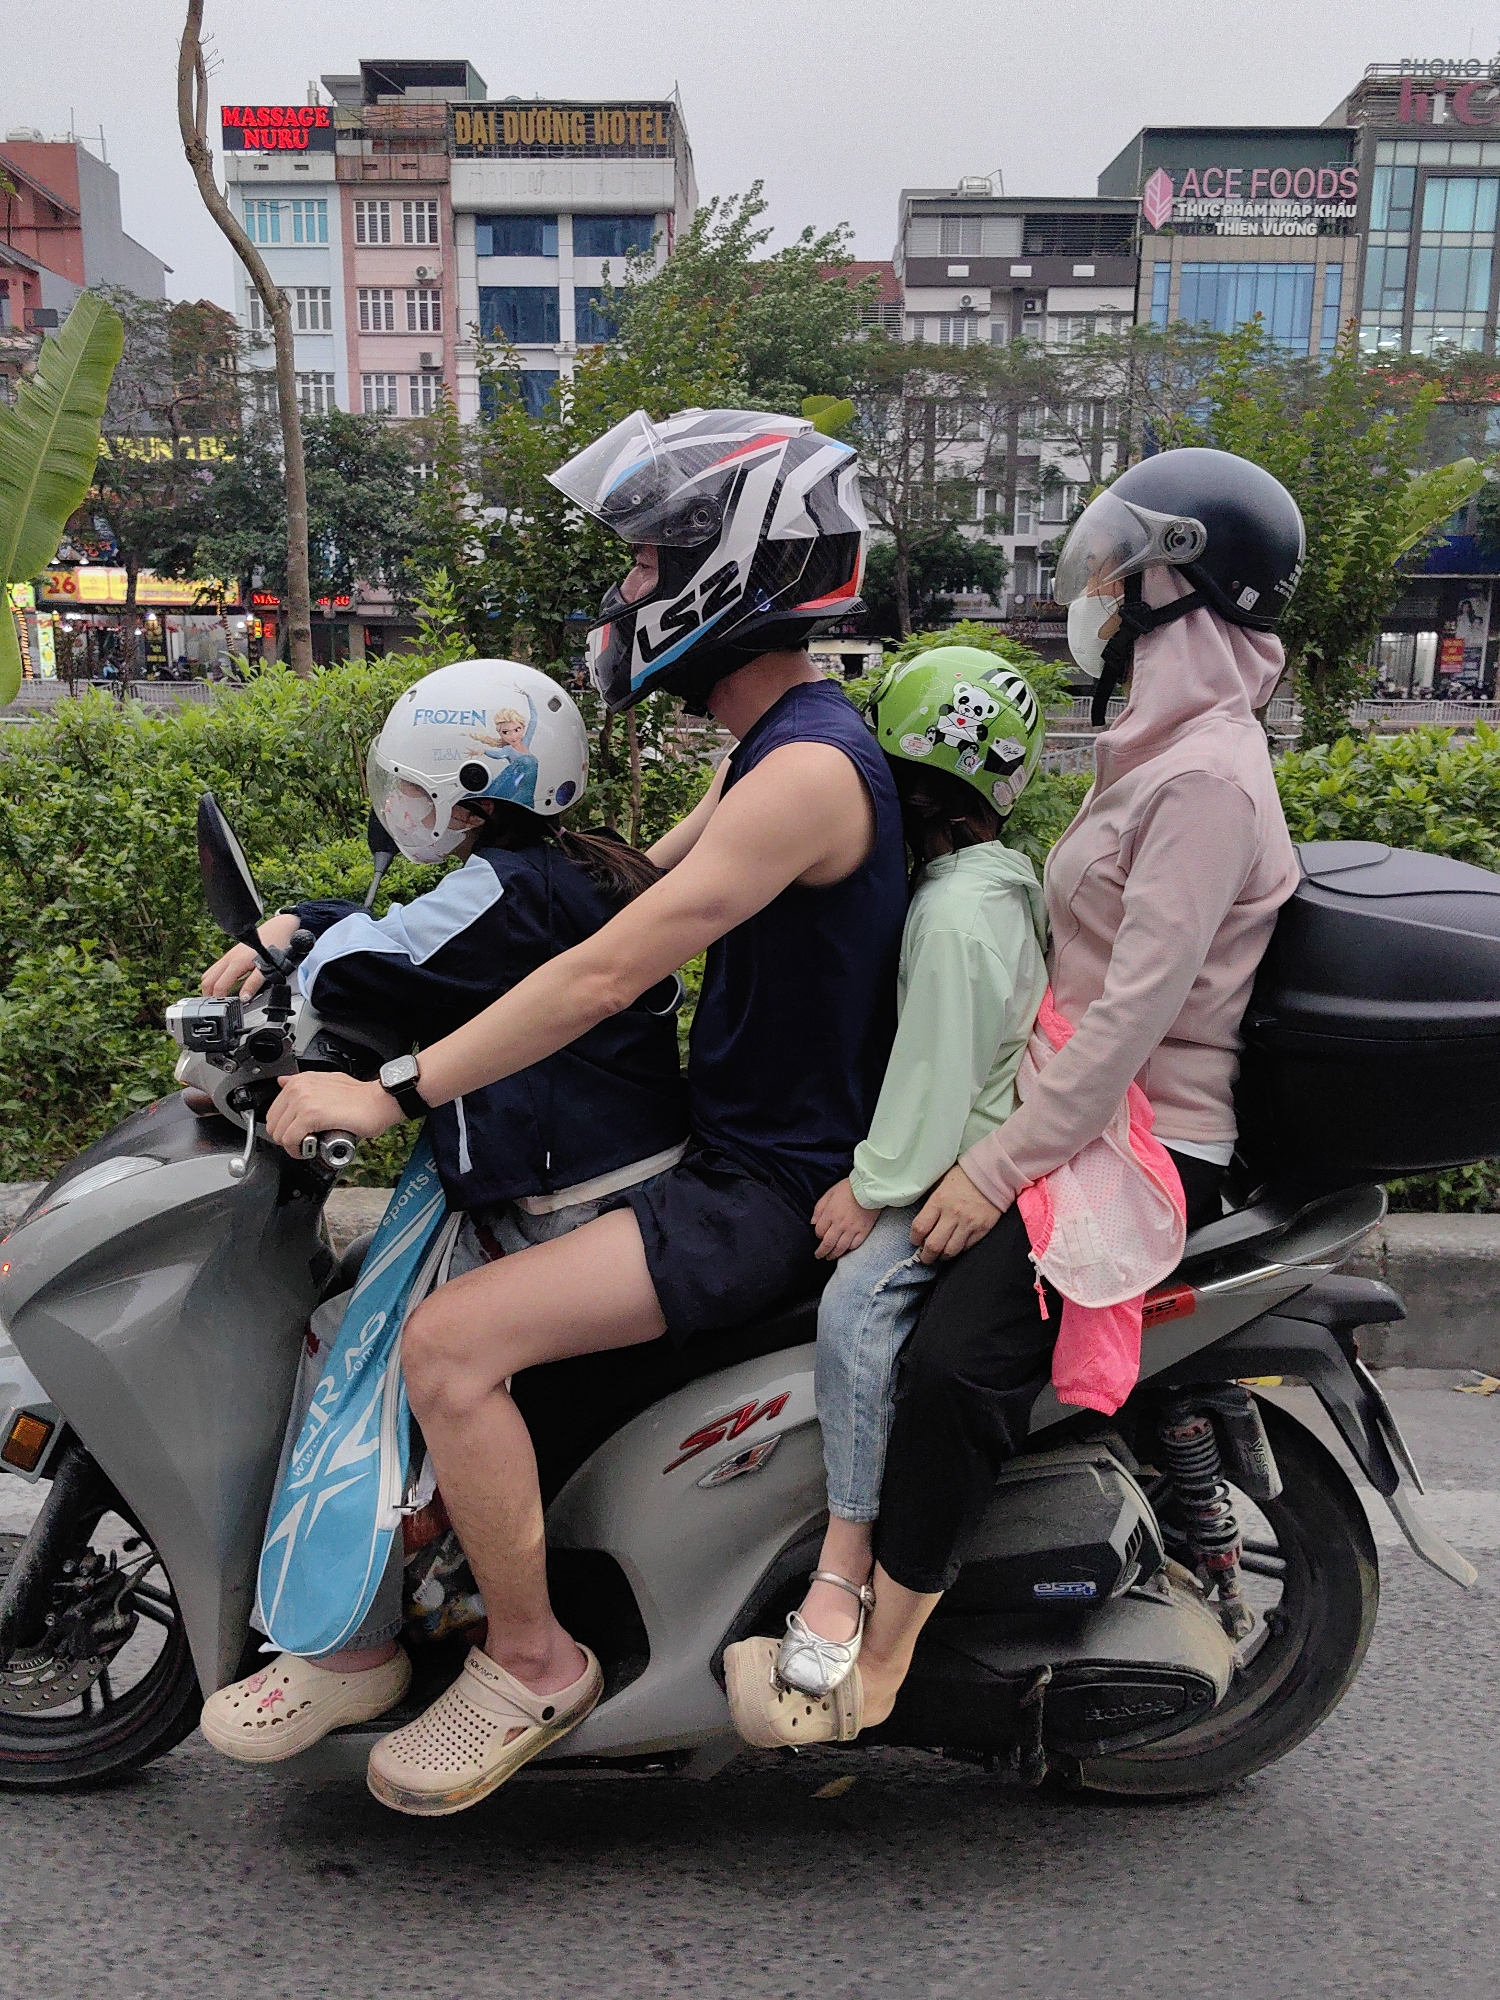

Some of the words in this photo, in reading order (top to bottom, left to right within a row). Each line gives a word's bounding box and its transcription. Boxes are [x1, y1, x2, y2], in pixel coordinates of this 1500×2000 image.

[221, 106, 330, 127] MASSAGE
[455, 110, 496, 151] ĐẠI
[503, 107, 586, 145] DƯƠNG
[594, 110, 669, 145] HOTEL
[243, 128, 309, 149] NURU
[1179, 167, 1243, 198] ACE
[1250, 167, 1360, 198] FOODS
[47, 576, 76, 594] 26
[636, 560, 743, 664] LS2
[412, 708, 487, 728] FROZEN
[382, 1173, 430, 1228] sports
